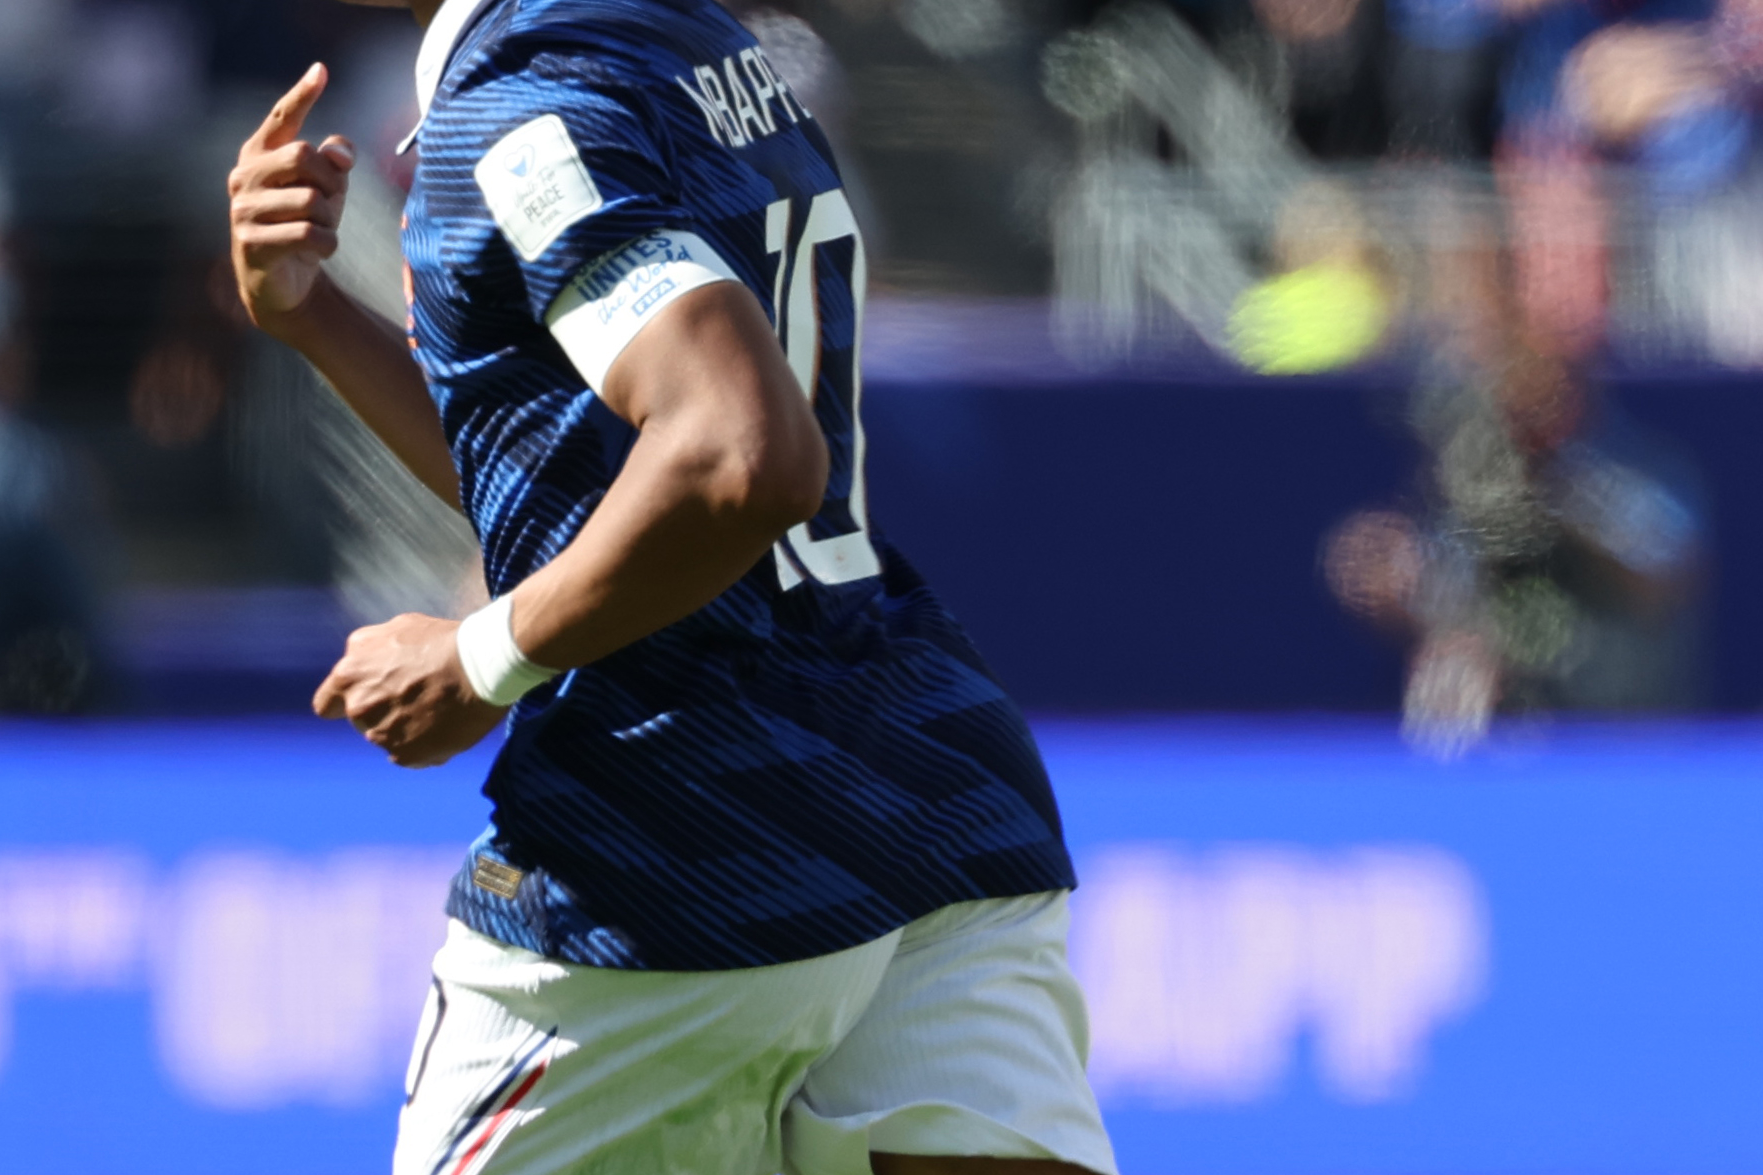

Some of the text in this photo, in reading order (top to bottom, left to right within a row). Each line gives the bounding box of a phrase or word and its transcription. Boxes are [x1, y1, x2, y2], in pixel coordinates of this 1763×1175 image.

[523, 183, 565, 224] PEACE
[577, 234, 672, 302] UNITES
[625, 244, 694, 293] World
[634, 279, 675, 316] FIFA
[765, 187, 883, 592] 10
